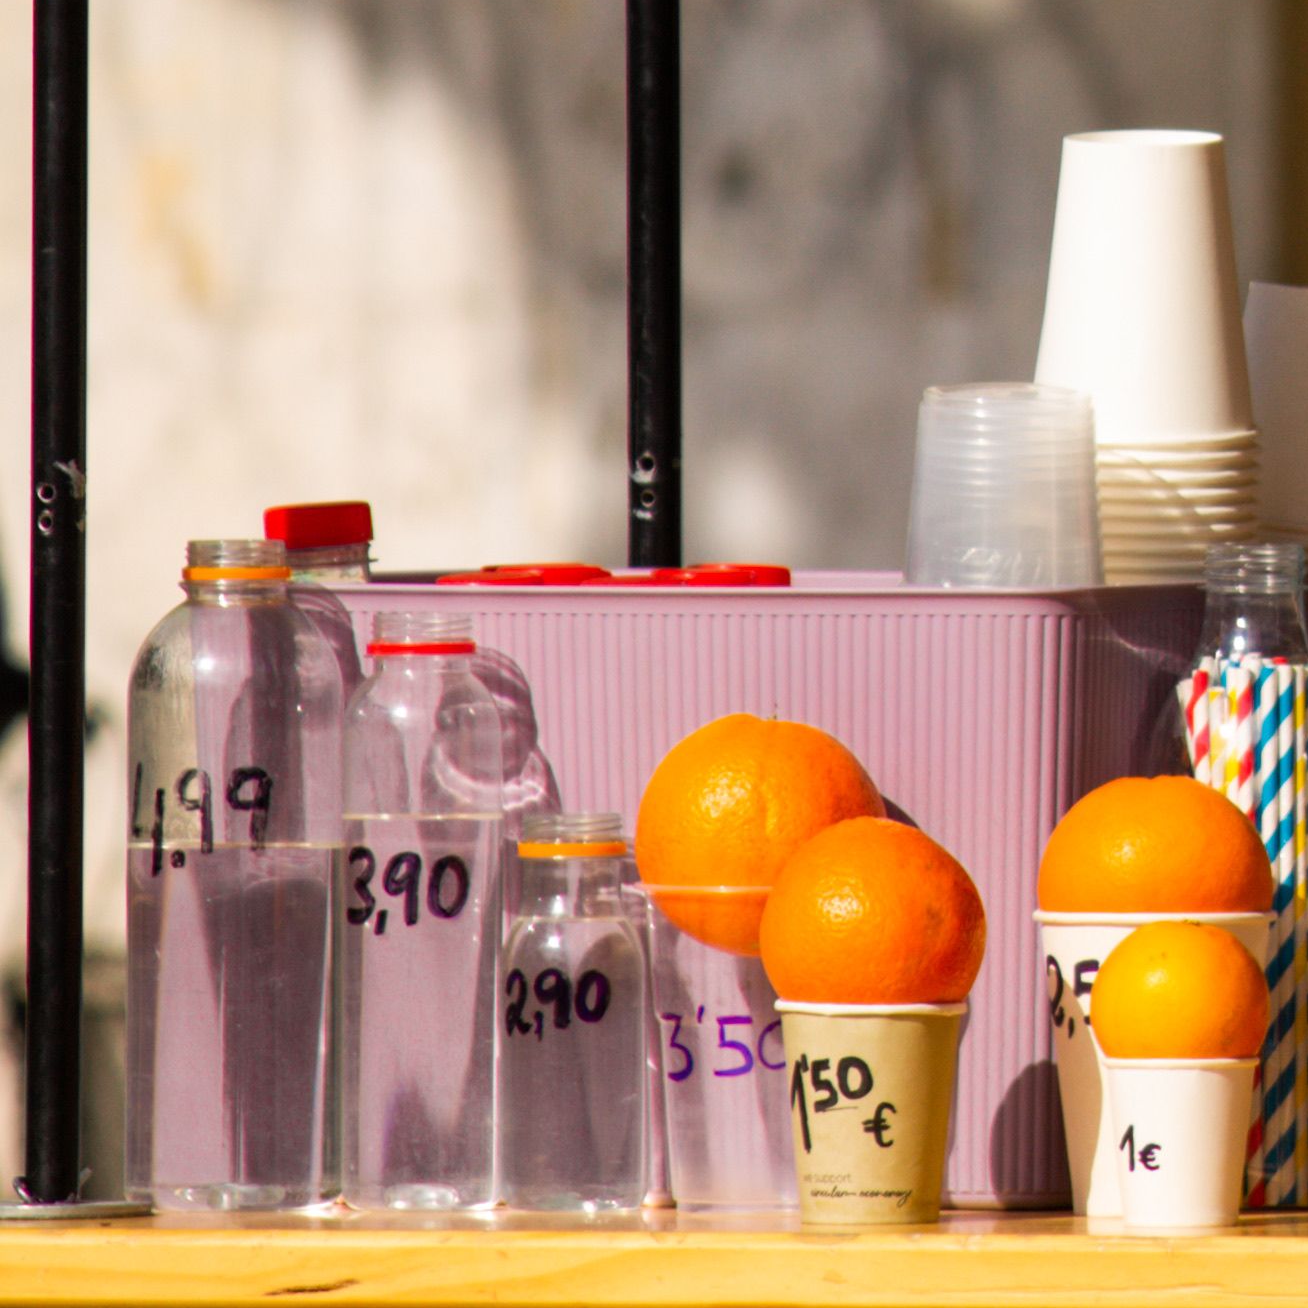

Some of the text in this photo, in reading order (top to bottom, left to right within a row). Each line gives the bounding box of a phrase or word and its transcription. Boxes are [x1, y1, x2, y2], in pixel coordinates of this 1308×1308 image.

[346, 846, 471, 935] 3,90
[505, 968, 612, 1041] 2,90
[862, 1102, 897, 1148] €
